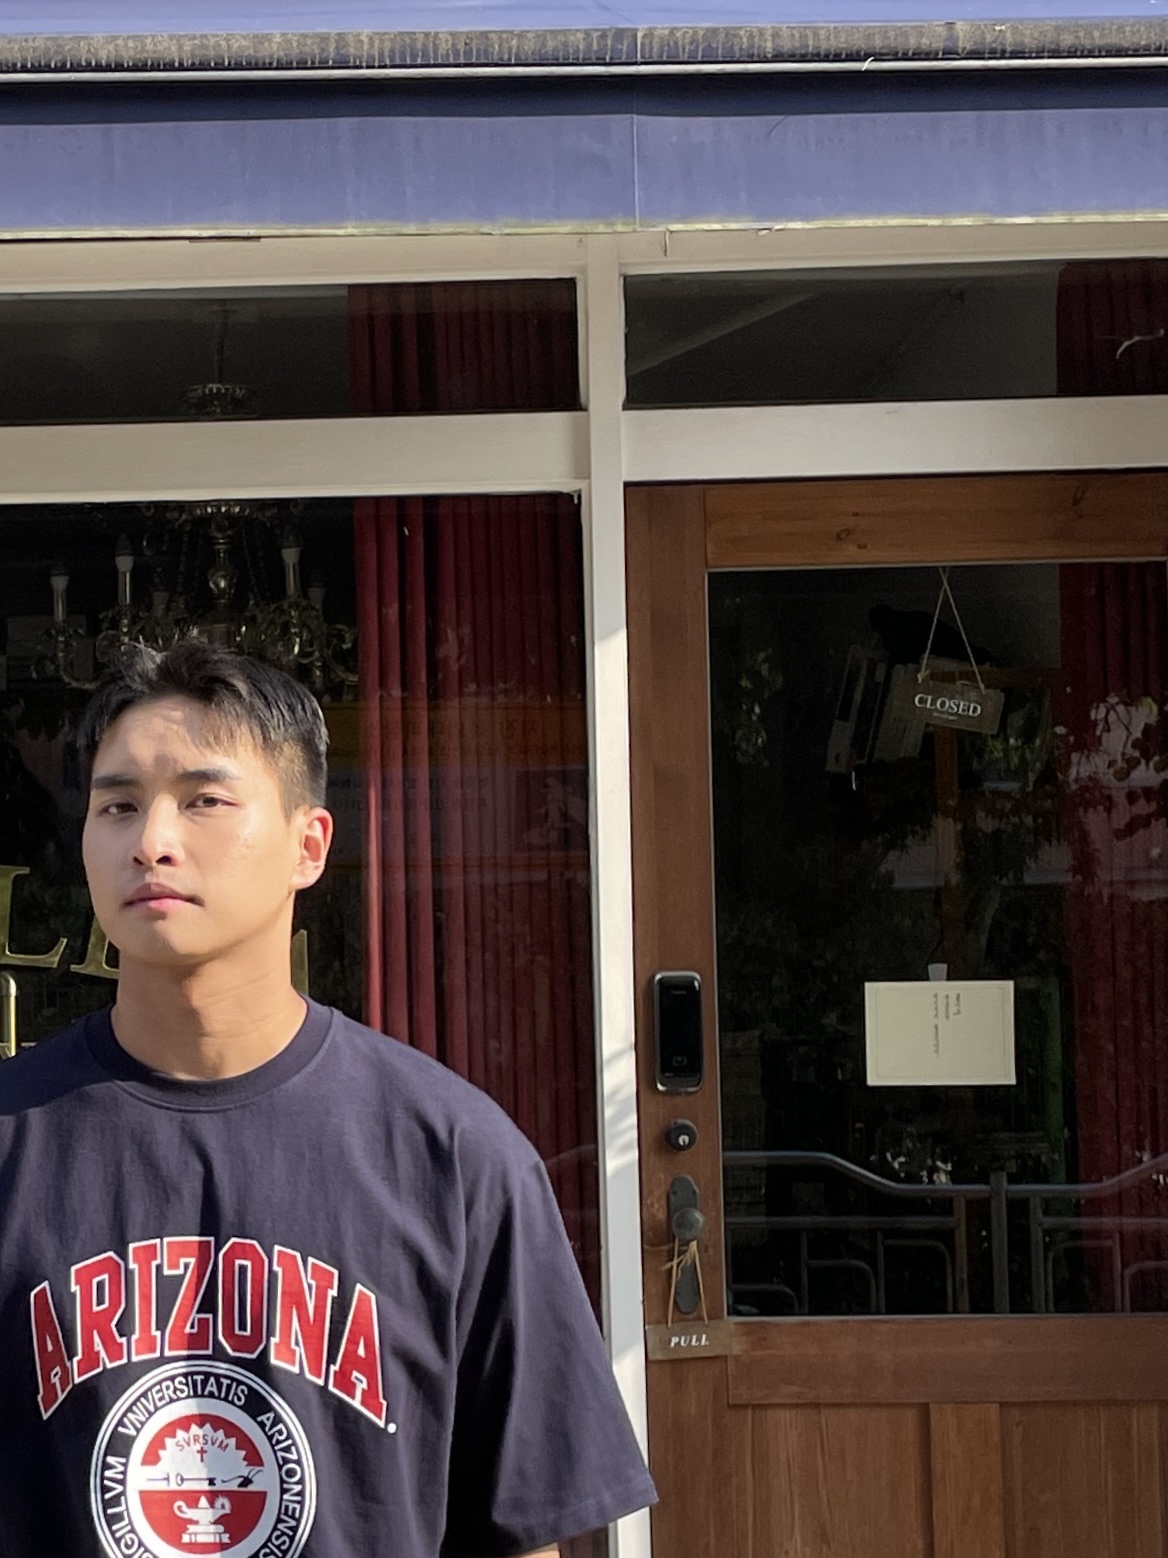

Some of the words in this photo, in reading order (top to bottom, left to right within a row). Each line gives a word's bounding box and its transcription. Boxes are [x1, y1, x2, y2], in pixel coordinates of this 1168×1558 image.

[914, 693, 982, 717] CLOSED
[30, 1236, 387, 1428] ARIZONA
[669, 1333, 710, 1348] PULL
[118, 1375, 248, 1438] VNIVERSITATIS
[175, 1433, 230, 1453] SVRSVM
